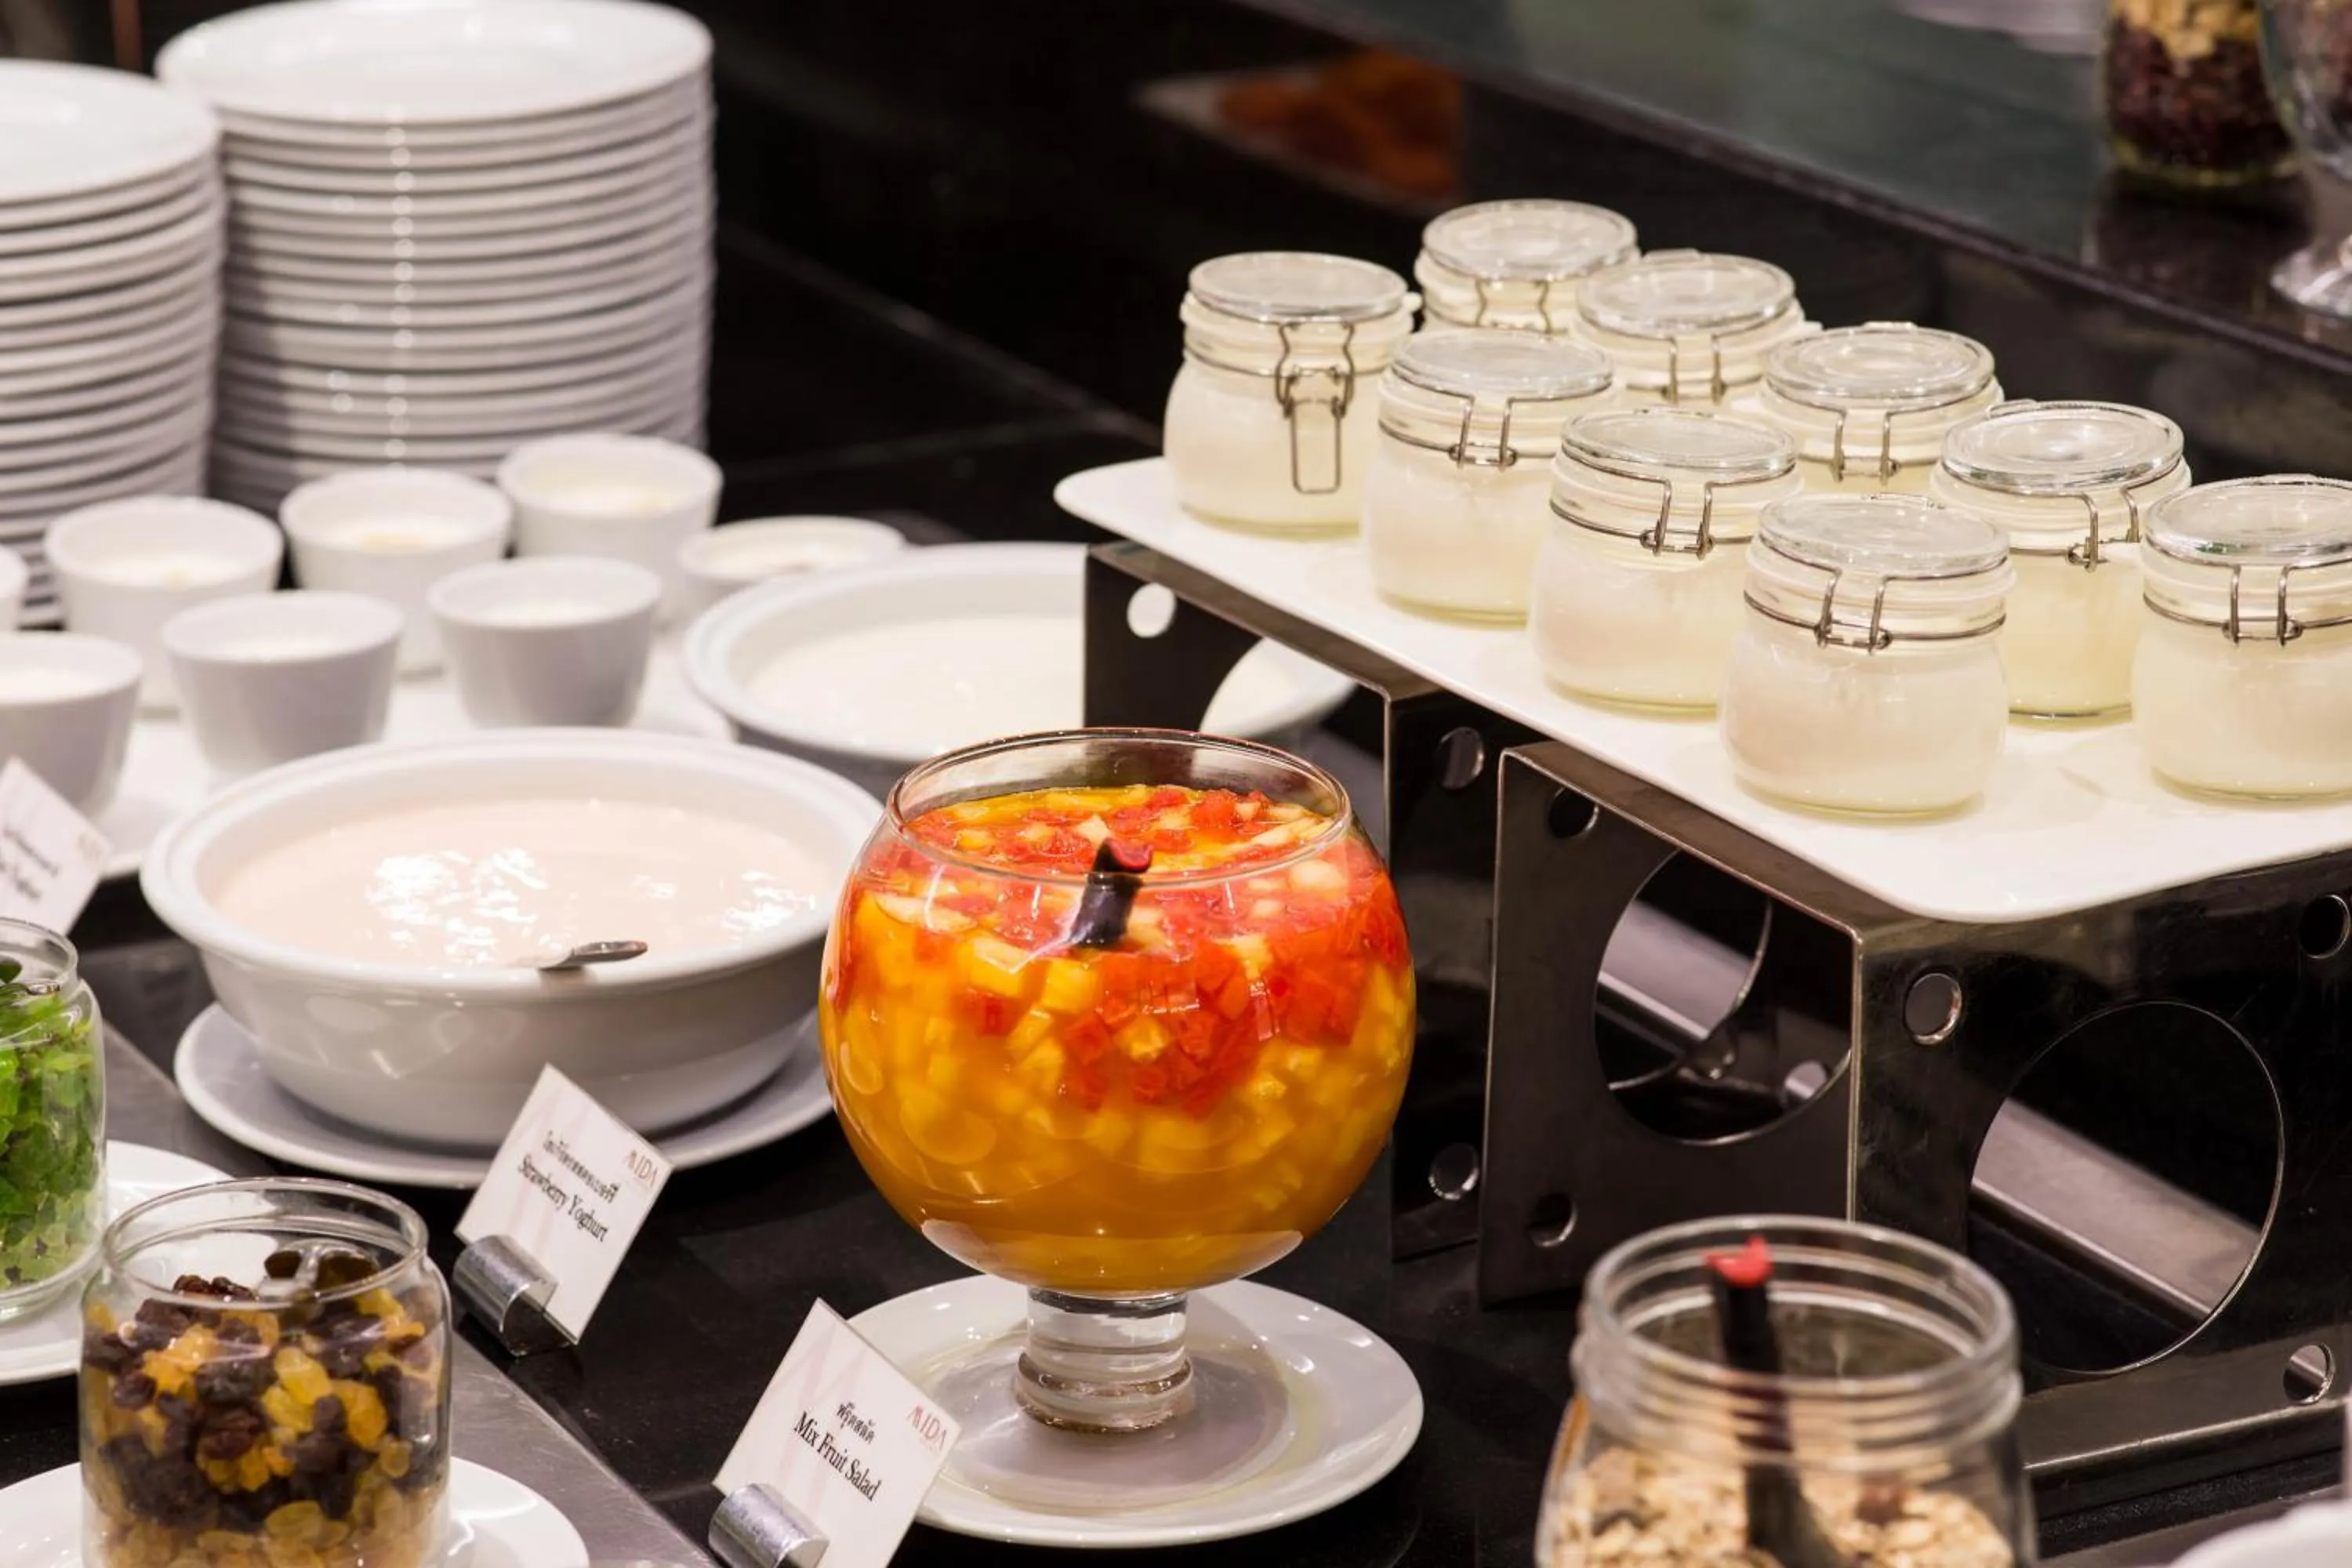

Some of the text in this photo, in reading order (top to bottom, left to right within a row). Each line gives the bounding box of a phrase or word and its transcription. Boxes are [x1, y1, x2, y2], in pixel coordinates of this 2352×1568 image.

[568, 1194, 608, 1242] Yoghurt
[793, 1410, 882, 1501] Mix Fruit Salad
